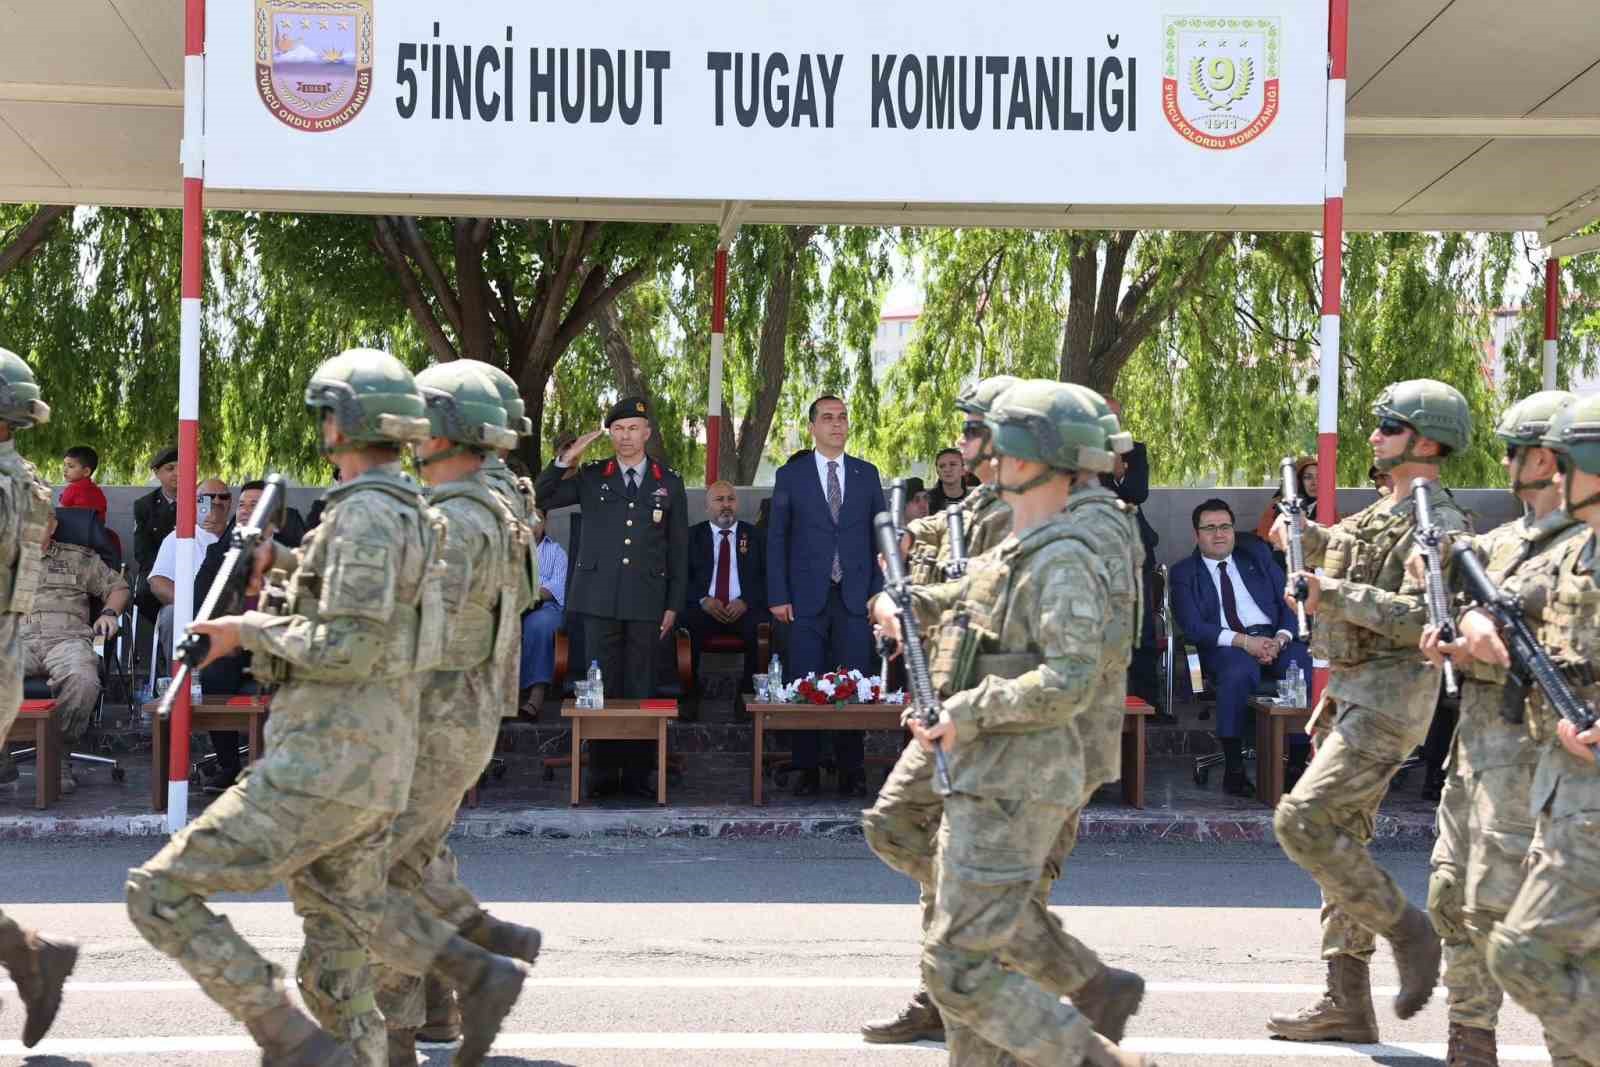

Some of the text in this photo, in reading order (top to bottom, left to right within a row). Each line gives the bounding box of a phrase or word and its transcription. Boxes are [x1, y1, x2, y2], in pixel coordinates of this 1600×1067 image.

[395, 21, 1137, 133] 5'İNCİ HUDUT TUGAY KOMUTANLIĞI
[1208, 57, 1236, 91] 9
[279, 110, 312, 129] ORDU
